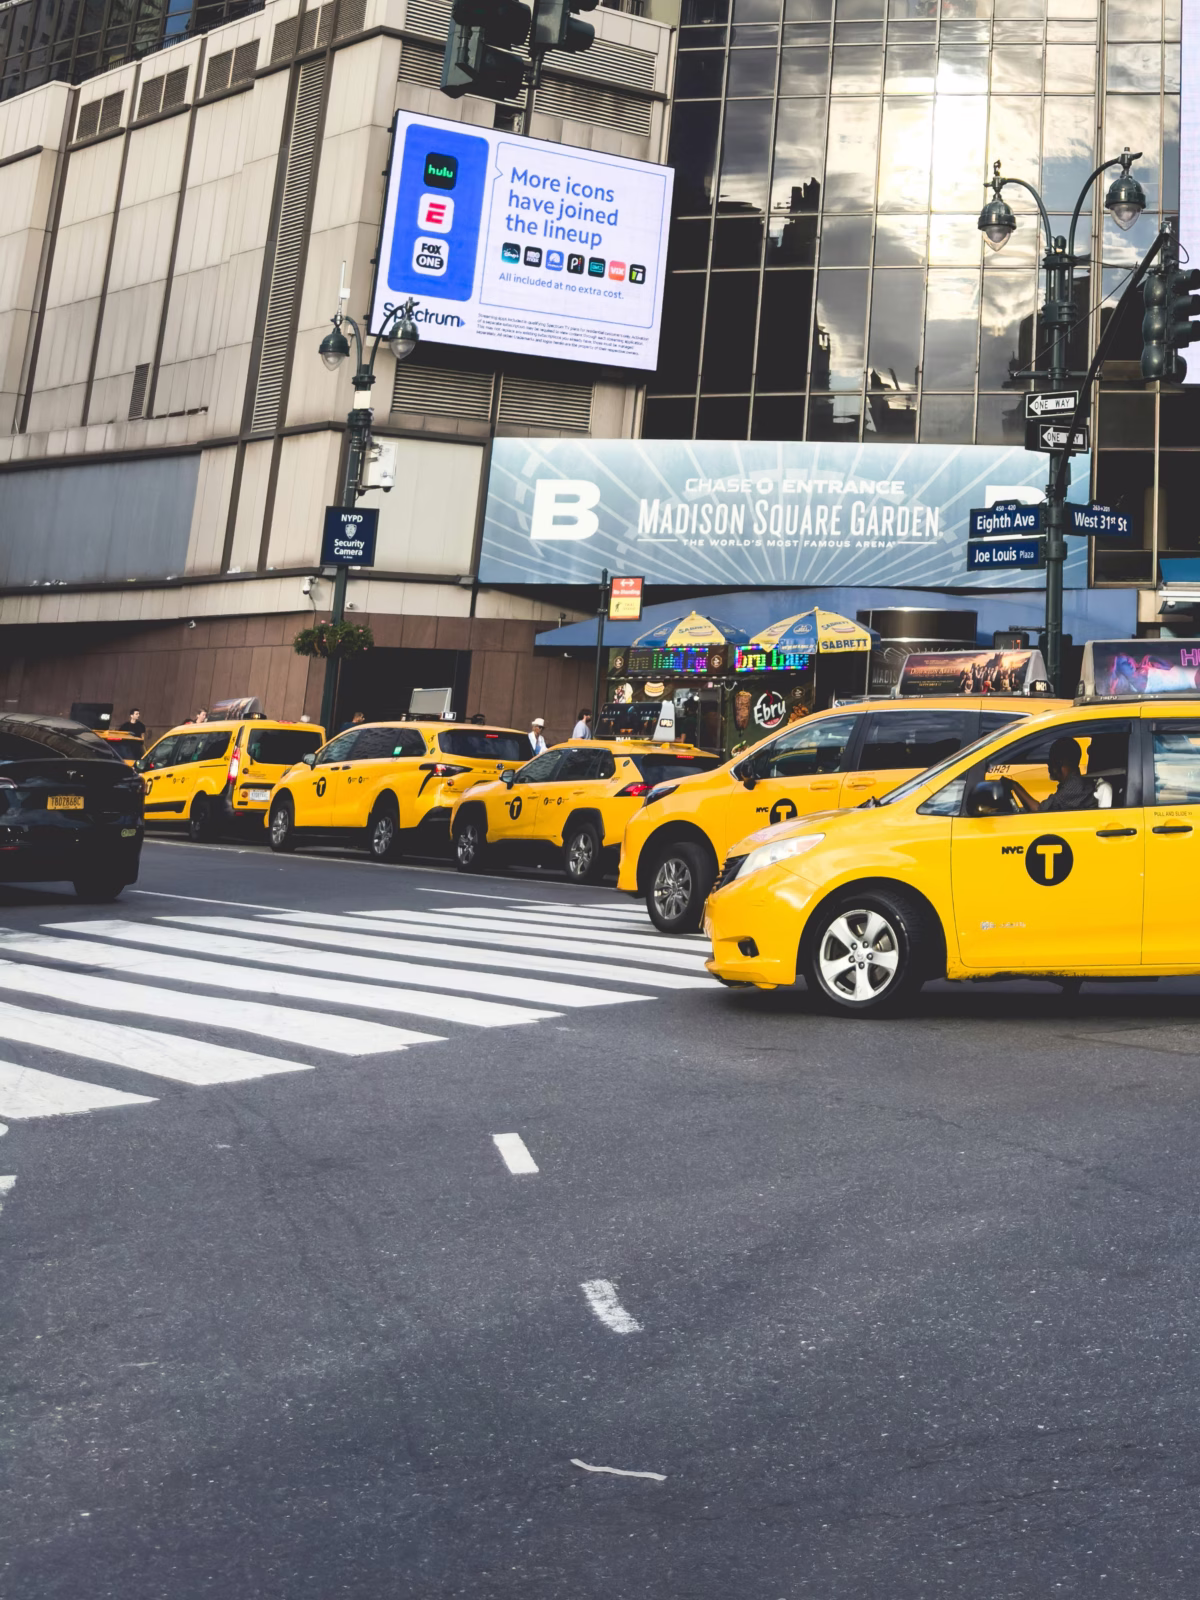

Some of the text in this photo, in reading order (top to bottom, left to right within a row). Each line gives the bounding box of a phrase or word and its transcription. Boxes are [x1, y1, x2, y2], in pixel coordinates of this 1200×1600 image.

[428, 164, 453, 178] hulu
[510, 167, 614, 202] More icons
[508, 189, 618, 226] have joined
[505, 214, 602, 250] the lineup
[421, 243, 442, 255] FOX
[419, 257, 441, 268] ONE
[499, 272, 624, 300] All included at no extra cost.
[1034, 399, 1070, 410] ONE WAY
[1047, 432, 1060, 442] ONE
[685, 477, 905, 495] CHASE ENTRANCE
[530, 479, 600, 540] B
[341, 514, 363, 523] NYPD
[637, 499, 744, 535] MADISON
[753, 499, 842, 538] SQUARE
[977, 512, 1035, 533] Eighth Ave
[1074, 512, 1127, 532] West 31st St
[334, 538, 365, 549] Security
[709, 539, 762, 547] WORLD'S
[334, 547, 363, 556] Camera
[974, 546, 1034, 563] Joe Louis Plaza
[821, 638, 868, 650] SABRETT
[754, 700, 787, 725] Ebru
[1002, 846, 1024, 854] NYC
